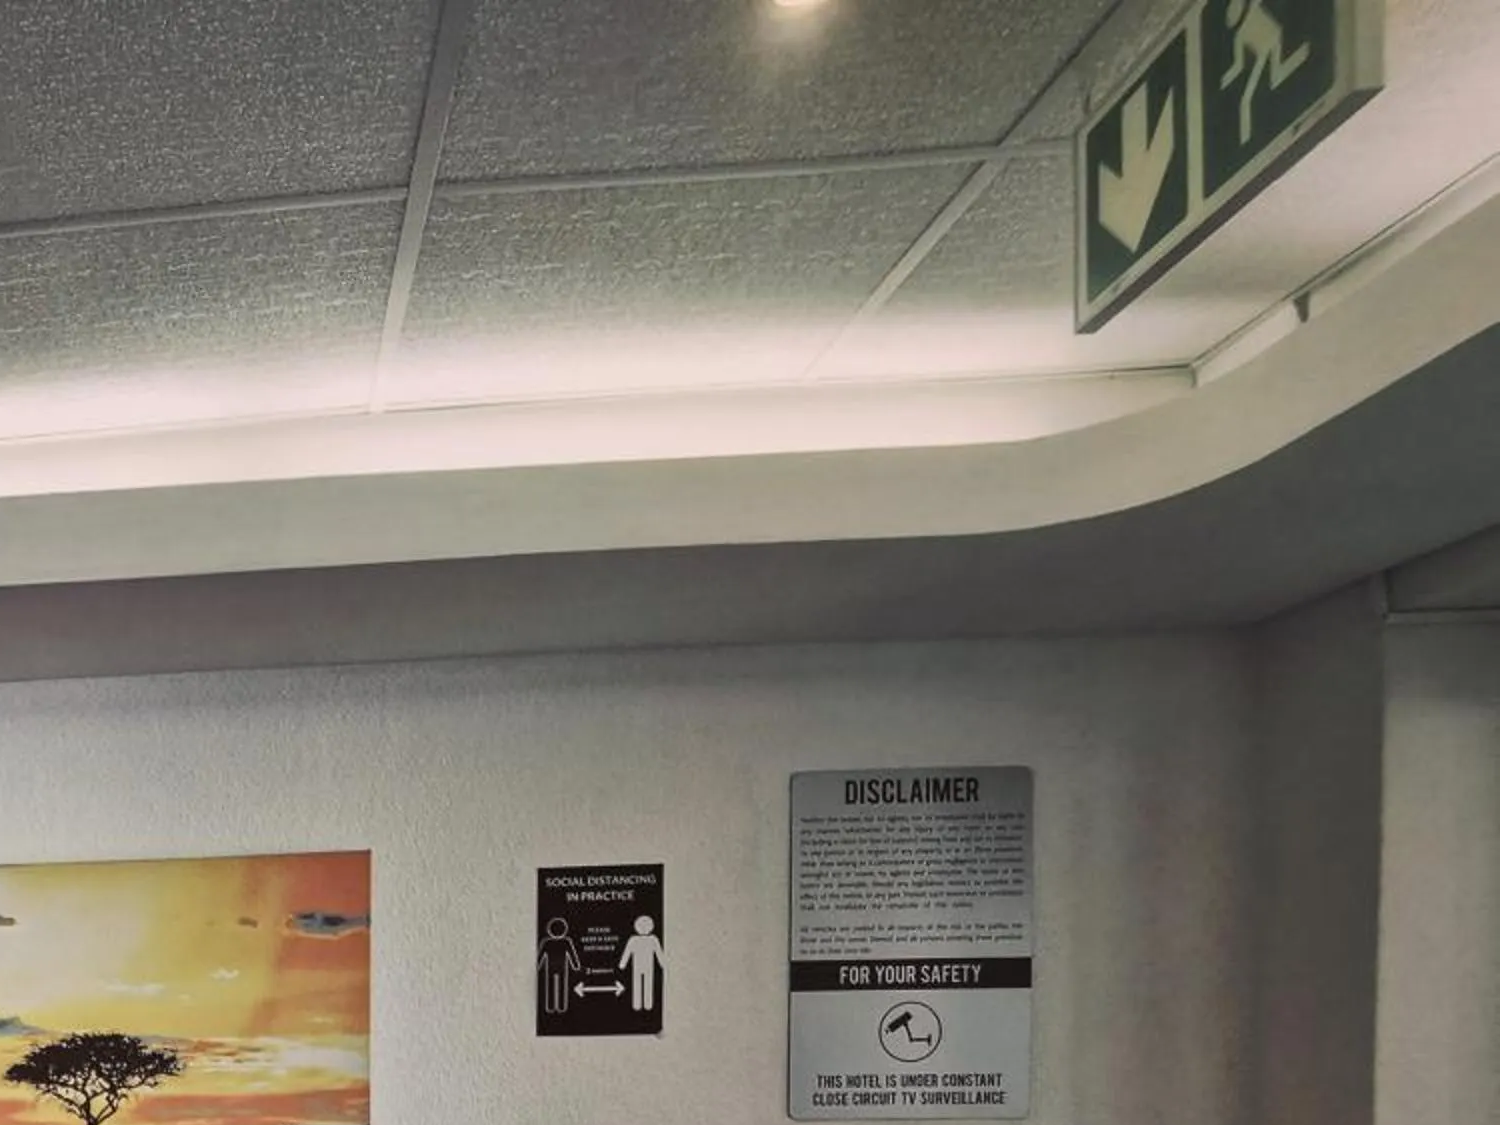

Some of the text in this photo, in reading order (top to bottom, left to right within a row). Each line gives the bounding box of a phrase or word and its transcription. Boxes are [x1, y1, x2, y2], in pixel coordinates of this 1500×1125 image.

[845, 777, 980, 804] DISCLAIMER
[545, 874, 657, 888] SOCIAL DISTANCING
[566, 890, 636, 902] IN PRACTICE
[839, 964, 982, 984] FOR YOUR SAFETY
[817, 1073, 1003, 1089] THIS HOTEL IS UNDER CONSTANT
[812, 1091, 1006, 1107] CLOSE CIRCUIT TV SURVEILLANCE
